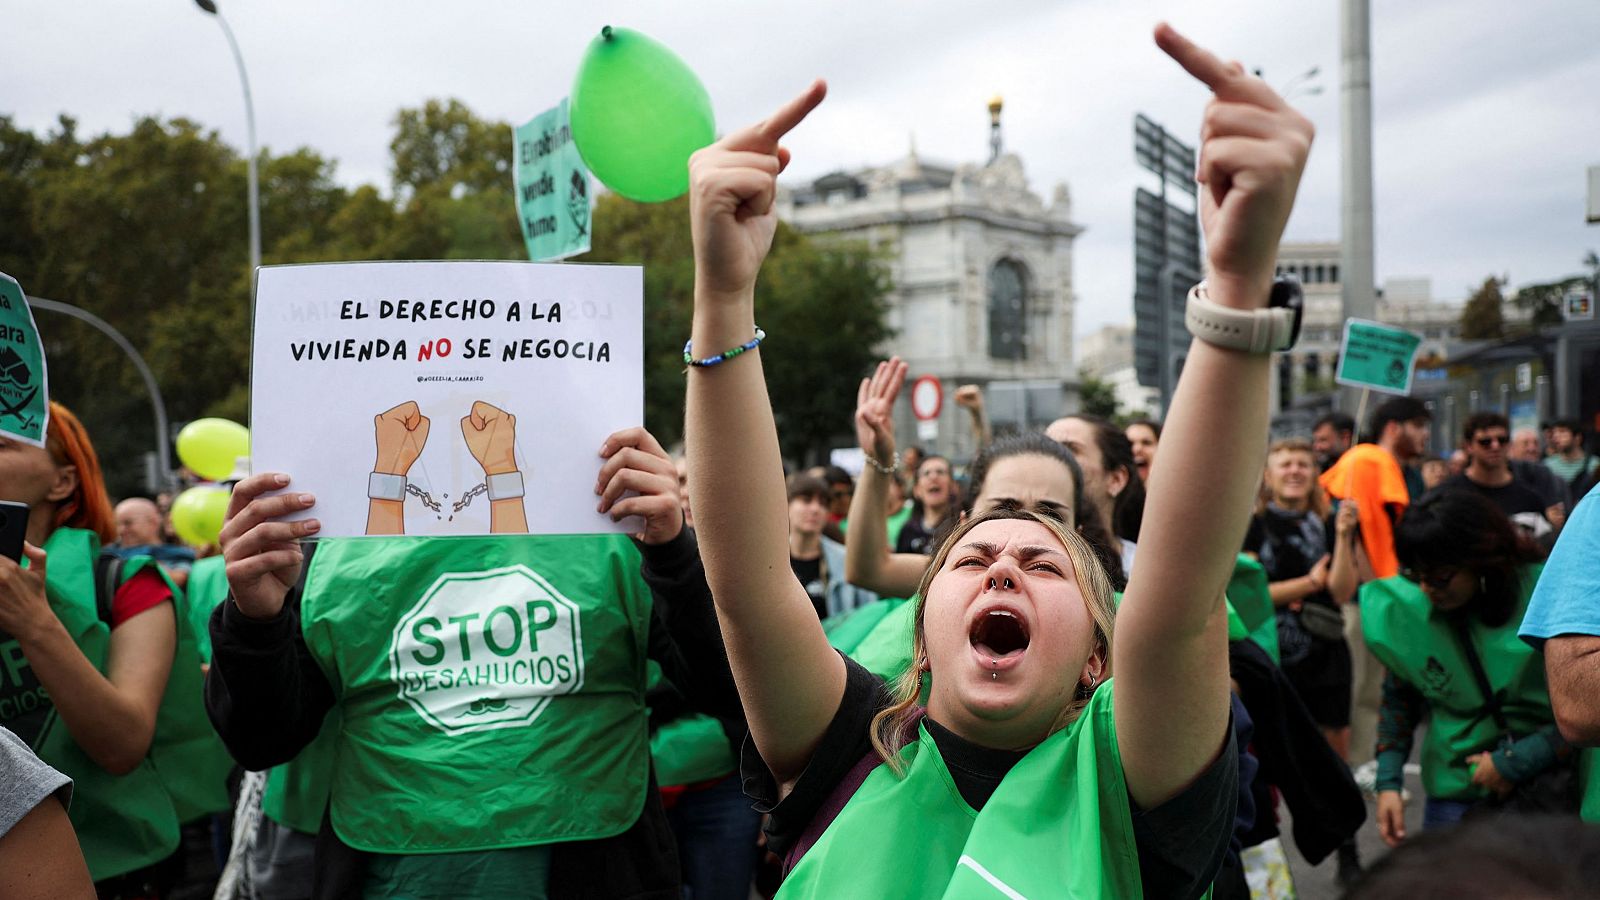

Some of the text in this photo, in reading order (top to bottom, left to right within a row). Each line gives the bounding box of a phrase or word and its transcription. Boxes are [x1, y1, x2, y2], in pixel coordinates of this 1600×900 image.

[341, 300, 369, 320] EL
[380, 299, 496, 323] DERECHO
[506, 301, 521, 322] A
[531, 302, 561, 323] LA
[291, 338, 610, 362] VIVIENDA NO SE NEGOCIA
[411, 600, 558, 666] STOP
[404, 654, 572, 692] DESAHUCIOS
